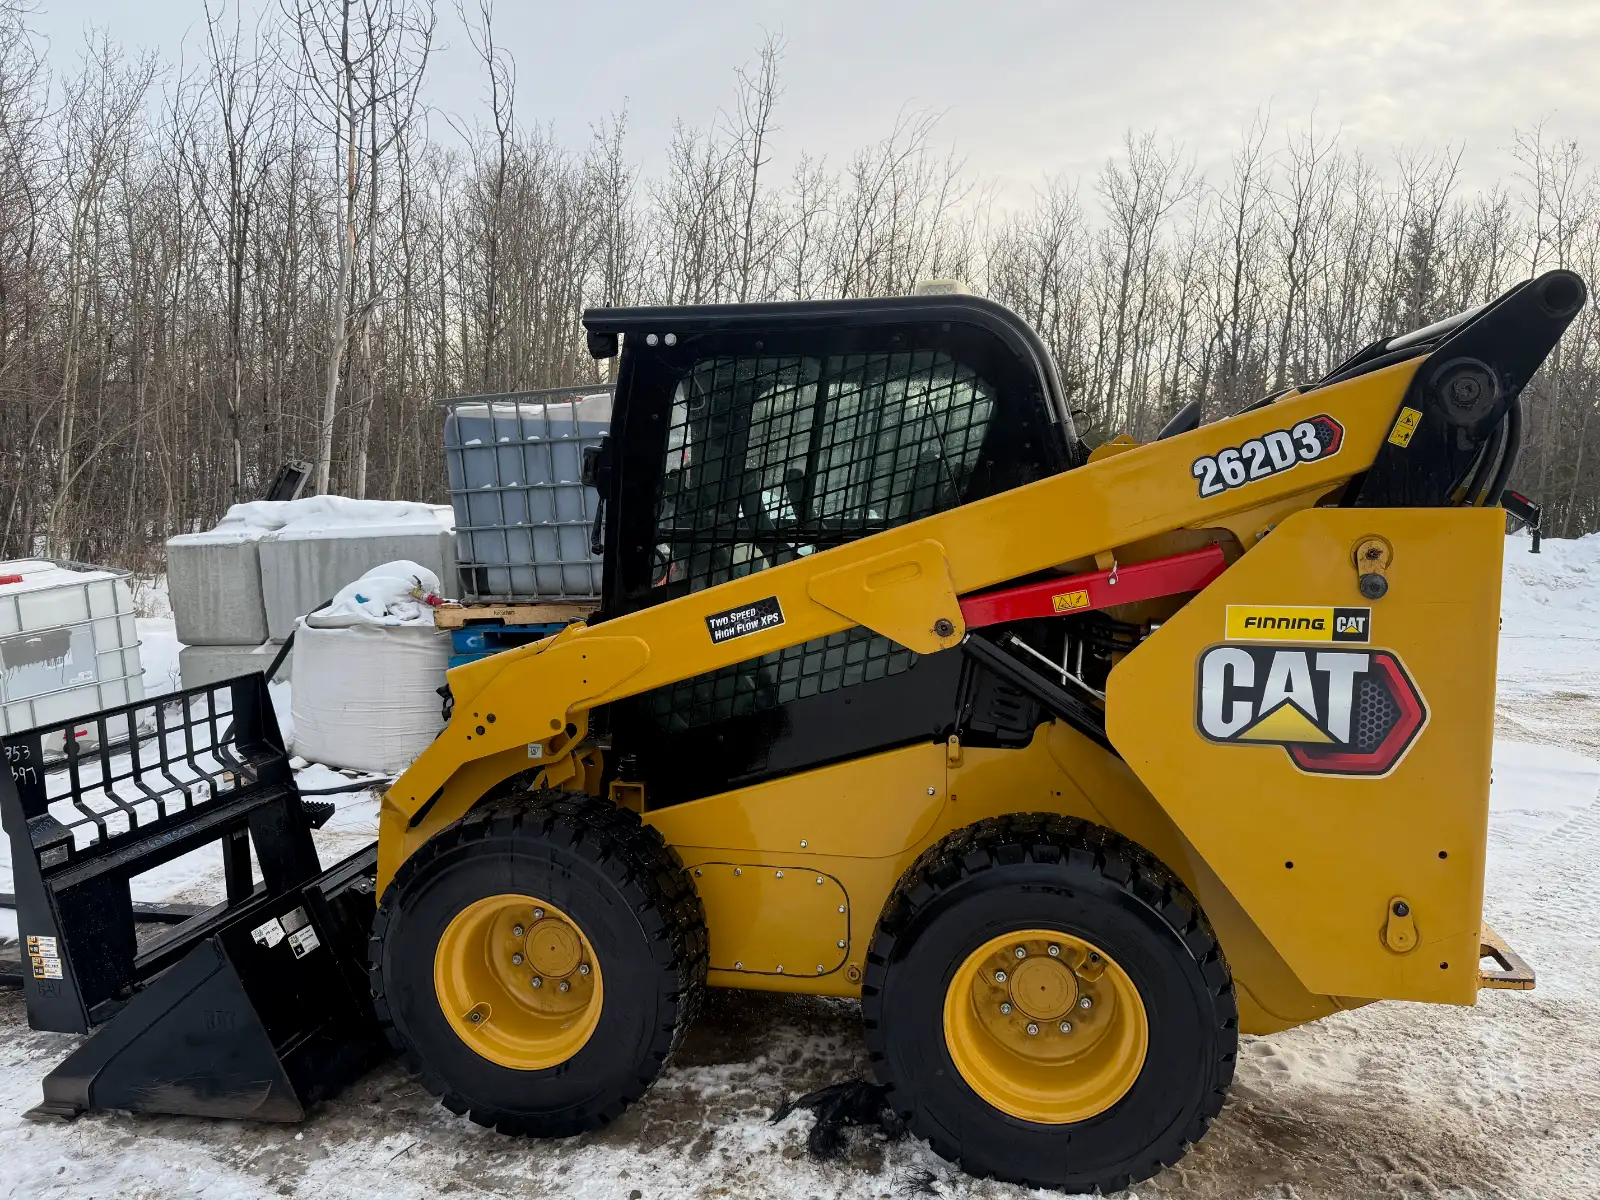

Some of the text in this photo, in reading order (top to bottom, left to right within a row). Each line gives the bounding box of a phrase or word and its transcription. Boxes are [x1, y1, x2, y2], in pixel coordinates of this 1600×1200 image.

[1193, 422, 1322, 496] 262D3
[760, 613, 779, 626] XPS
[1244, 616, 1366, 633] FINNING CAT
[1201, 647, 1370, 744] CAT
